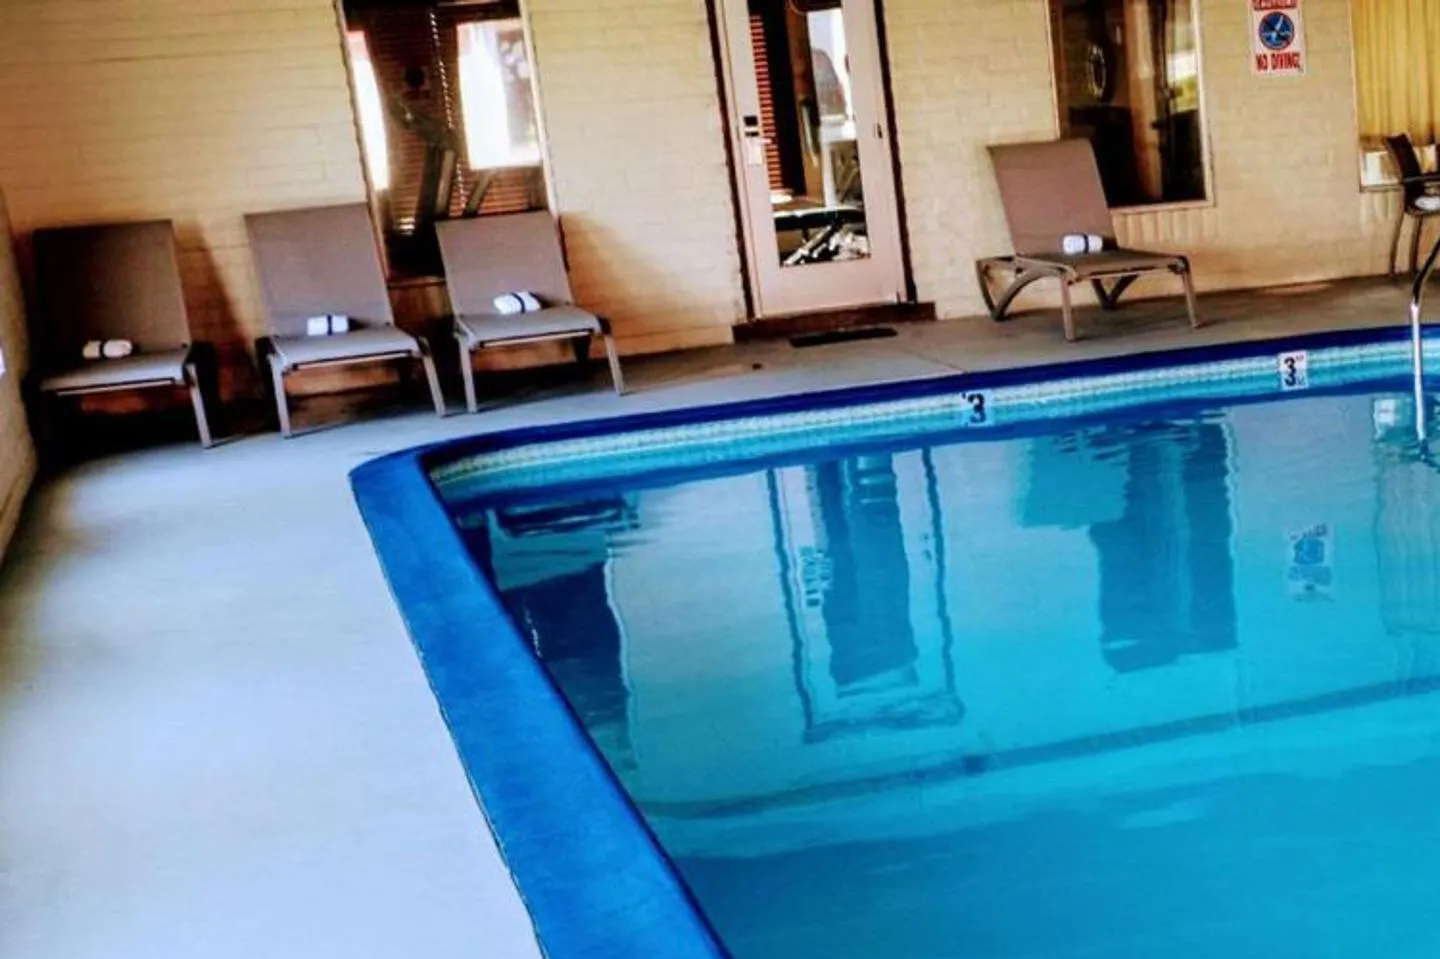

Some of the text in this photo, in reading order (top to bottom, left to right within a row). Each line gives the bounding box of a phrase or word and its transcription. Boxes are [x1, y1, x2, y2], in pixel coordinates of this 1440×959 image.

[1256, 53, 1268, 71] NO
[1284, 356, 1296, 387] 3
[968, 393, 986, 424] 3
